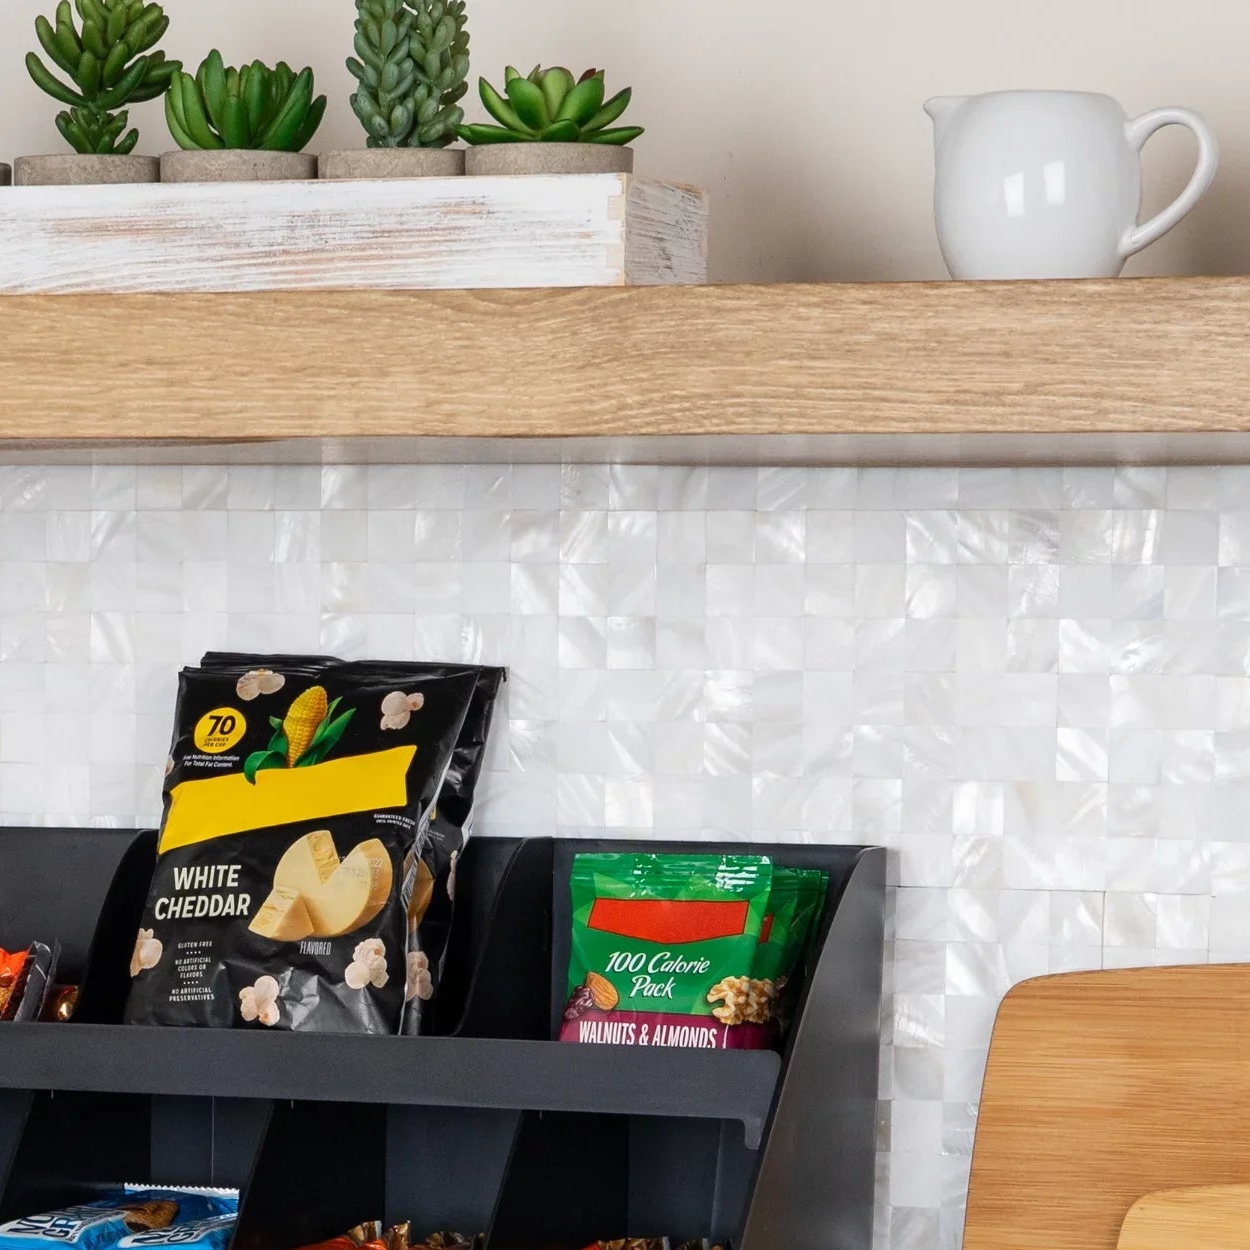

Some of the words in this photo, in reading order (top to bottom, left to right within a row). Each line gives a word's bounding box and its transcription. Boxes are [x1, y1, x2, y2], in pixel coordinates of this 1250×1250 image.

[207, 714, 237, 737] 70
[212, 754, 240, 762] Information
[173, 864, 242, 890] WHITE
[154, 893, 250, 921] CHEDDAR
[300, 941, 332, 955] FLAVORED
[183, 957, 212, 965] ARTIFICIAL
[605, 951, 646, 974] 100
[647, 951, 711, 975] Calorie
[180, 987, 212, 995] ARTIFICIAL
[629, 976, 676, 999] Pack
[579, 1021, 636, 1046] WALNUTS
[639, 1025, 649, 1046] &
[651, 1024, 718, 1049] ALMONDS
